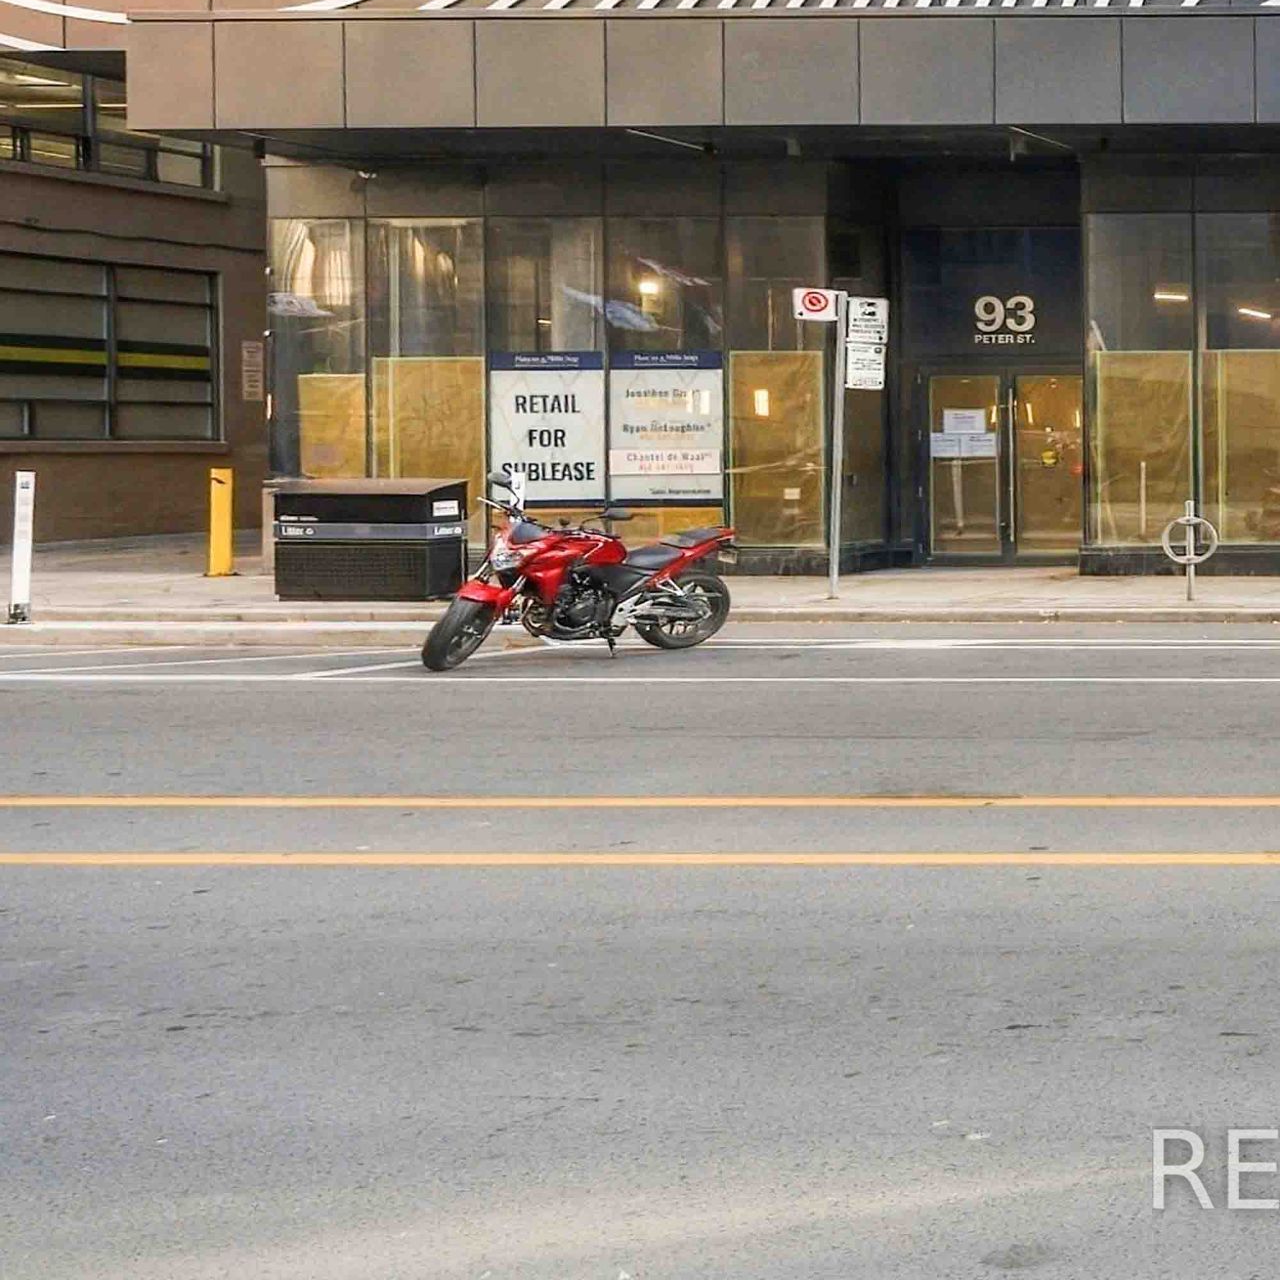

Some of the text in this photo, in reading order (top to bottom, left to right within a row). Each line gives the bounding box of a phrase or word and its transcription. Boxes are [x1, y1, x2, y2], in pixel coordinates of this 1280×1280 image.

[974, 295, 1036, 333] 93
[974, 334, 1036, 344] PETER ST.
[514, 394, 580, 414] RETAIL
[528, 428, 566, 448] FOR
